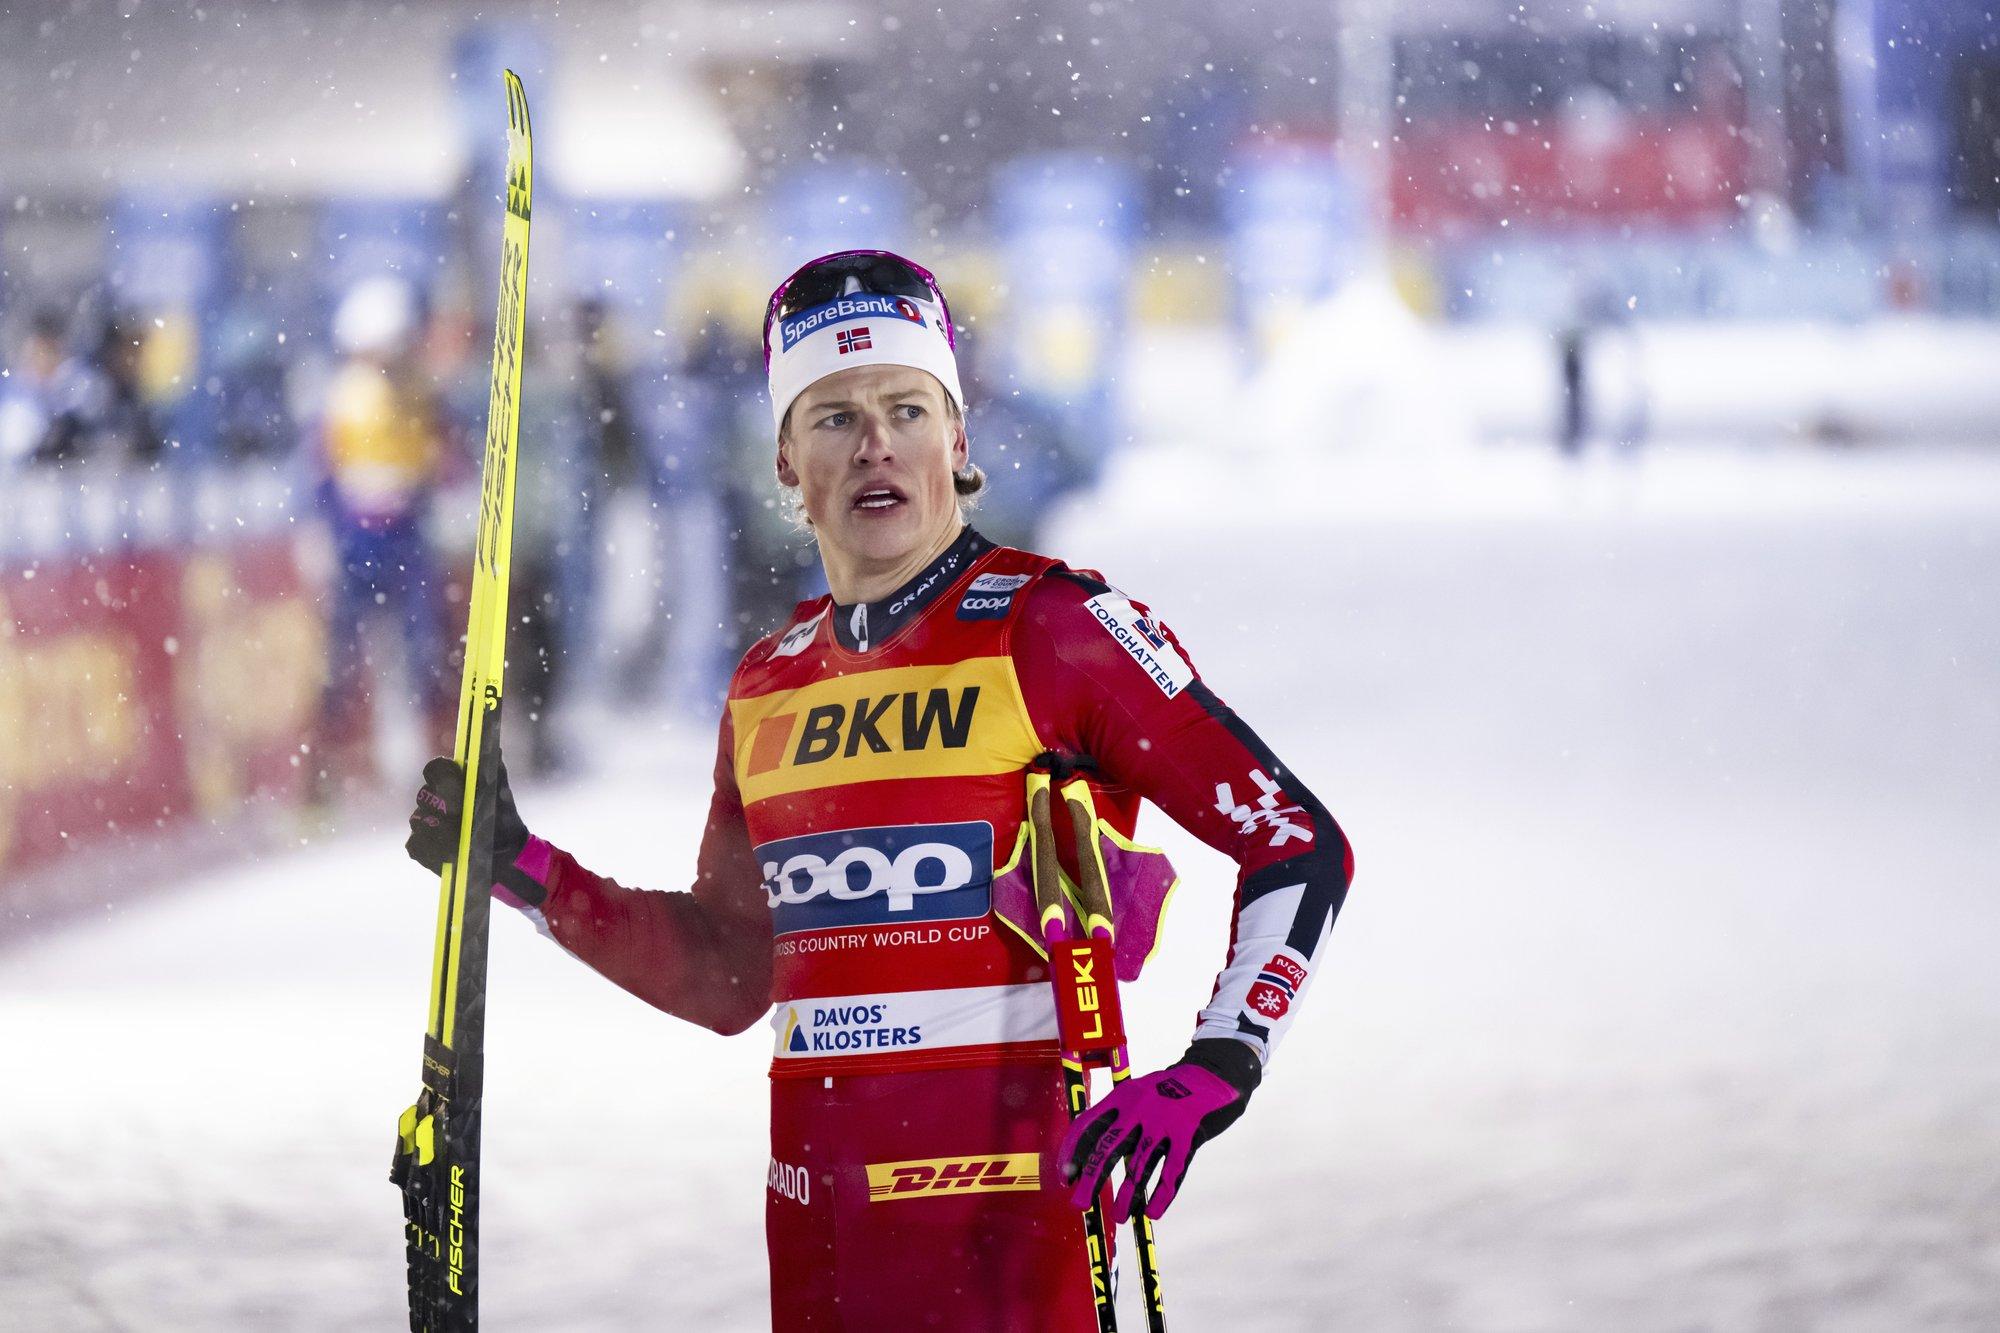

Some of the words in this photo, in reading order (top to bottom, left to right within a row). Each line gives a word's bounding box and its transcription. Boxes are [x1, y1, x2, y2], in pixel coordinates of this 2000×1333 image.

[785, 298, 896, 343] SpareBank
[962, 596, 1010, 611] coop
[1089, 600, 1178, 695] TORGHATTEN
[793, 686, 981, 766] BKW
[799, 933, 868, 953] COUNTRY
[874, 929, 942, 948] WORLD
[948, 925, 990, 942] CUP
[1072, 948, 1103, 1039] LEKI
[813, 1004, 883, 1027] DAVOS
[813, 1026, 921, 1051] KLOSTERS
[891, 1161, 1018, 1193] DHL
[449, 1165, 465, 1296] FISCHER
